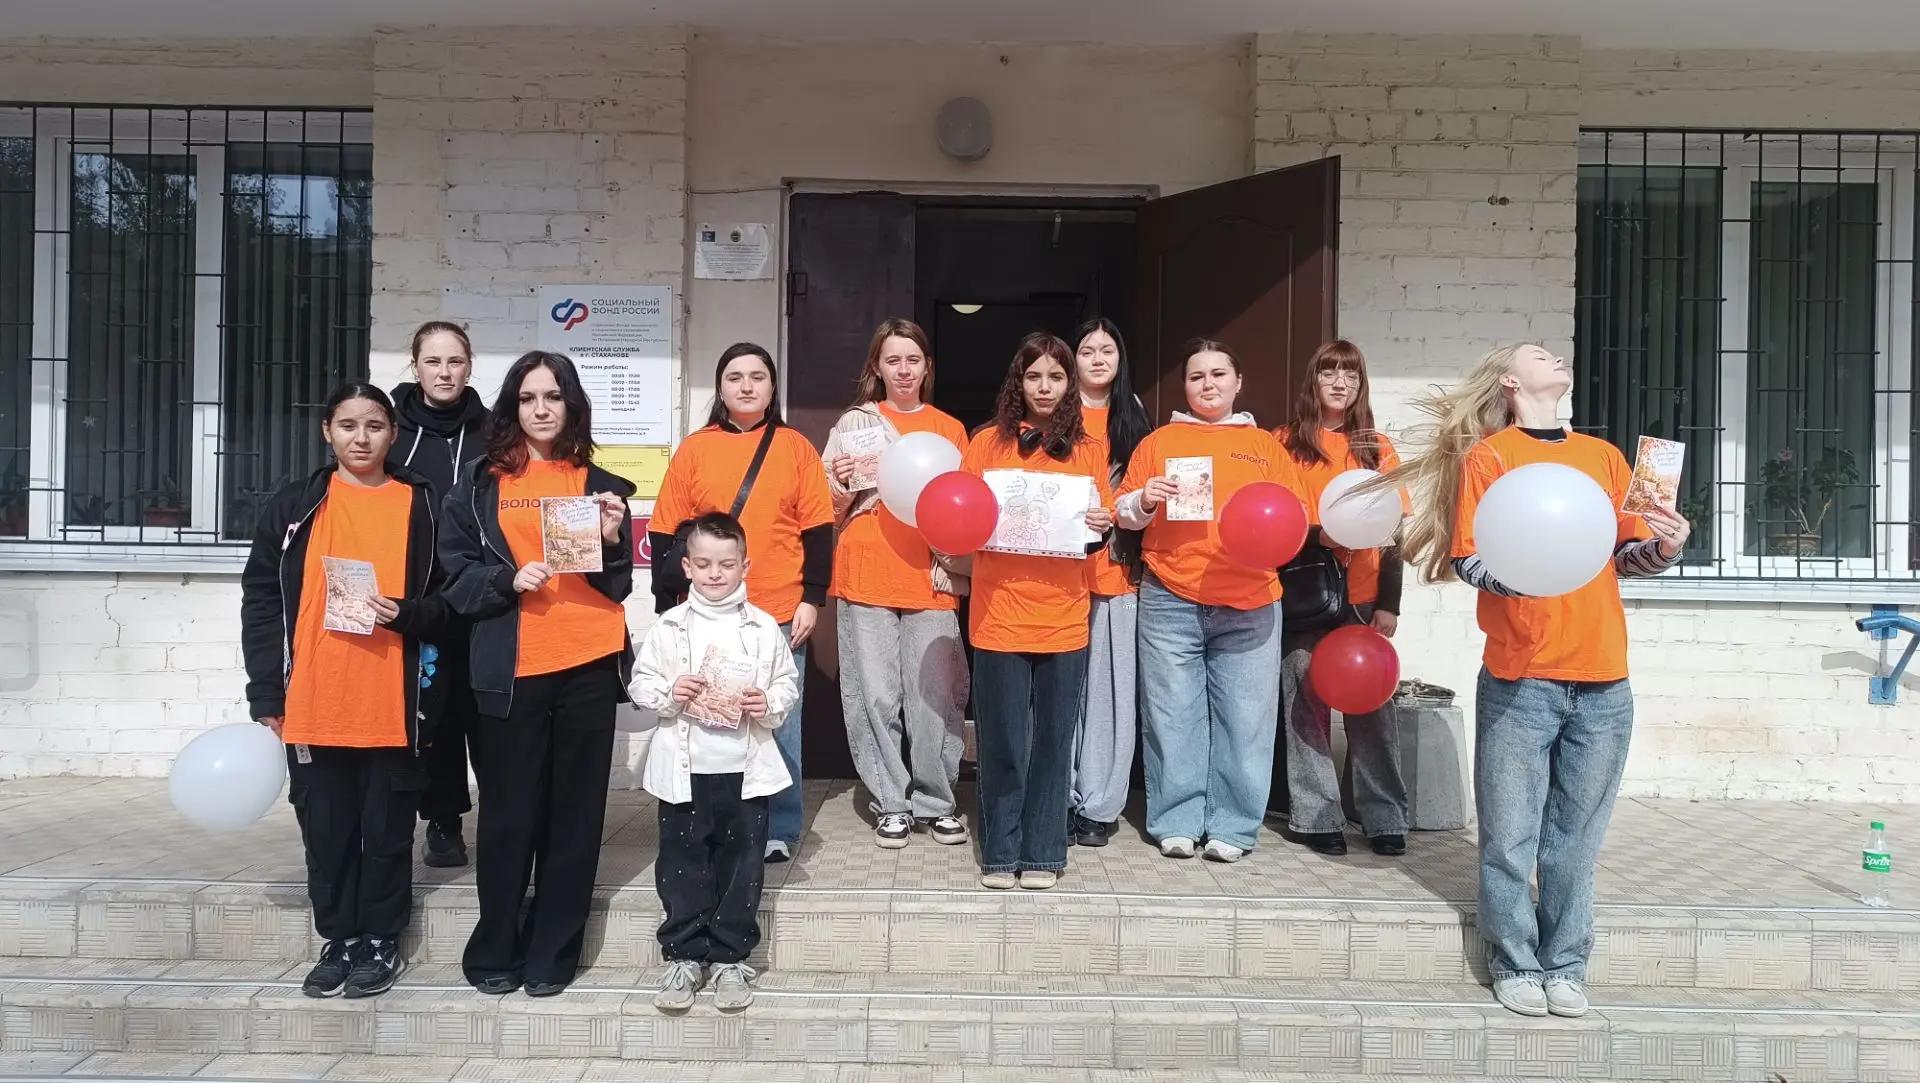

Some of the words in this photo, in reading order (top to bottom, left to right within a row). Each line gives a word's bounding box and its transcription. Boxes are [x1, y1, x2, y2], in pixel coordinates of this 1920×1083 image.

[591, 298, 660, 307] СОЦИАЛЬНЫЙ
[591, 307, 620, 315] ФОНД
[622, 307, 660, 315] РОССИИ
